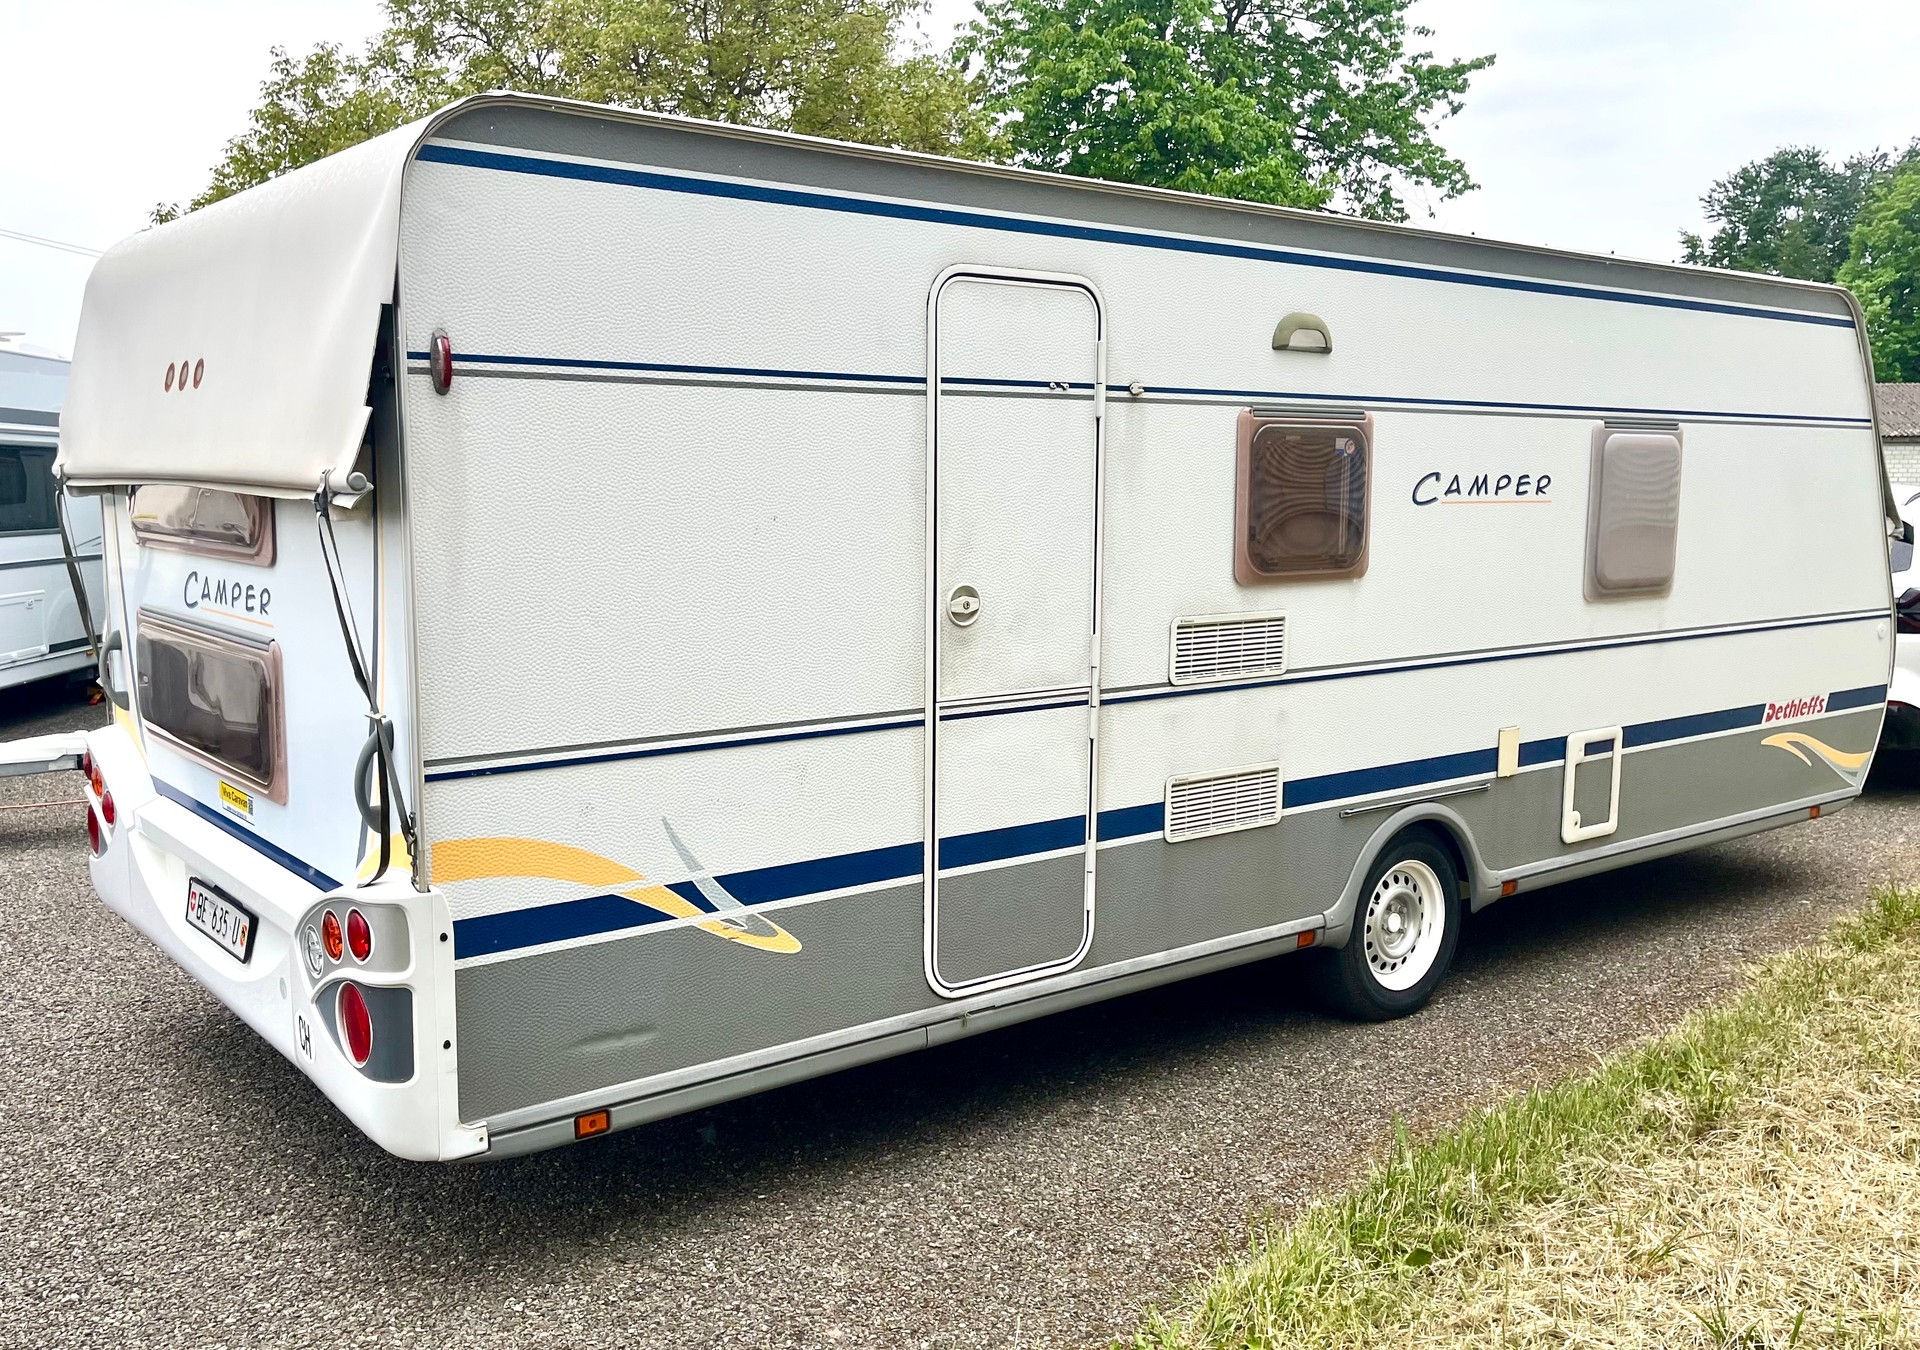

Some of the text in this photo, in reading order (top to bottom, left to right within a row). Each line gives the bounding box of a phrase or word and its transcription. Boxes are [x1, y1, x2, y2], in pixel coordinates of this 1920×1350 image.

[1412, 471, 1552, 506] CAMPER
[184, 571, 271, 615] CAMPER
[1765, 695, 1825, 723] Dethleffs
[196, 892, 241, 945] BE 635 U
[299, 1015, 312, 1060] CH
